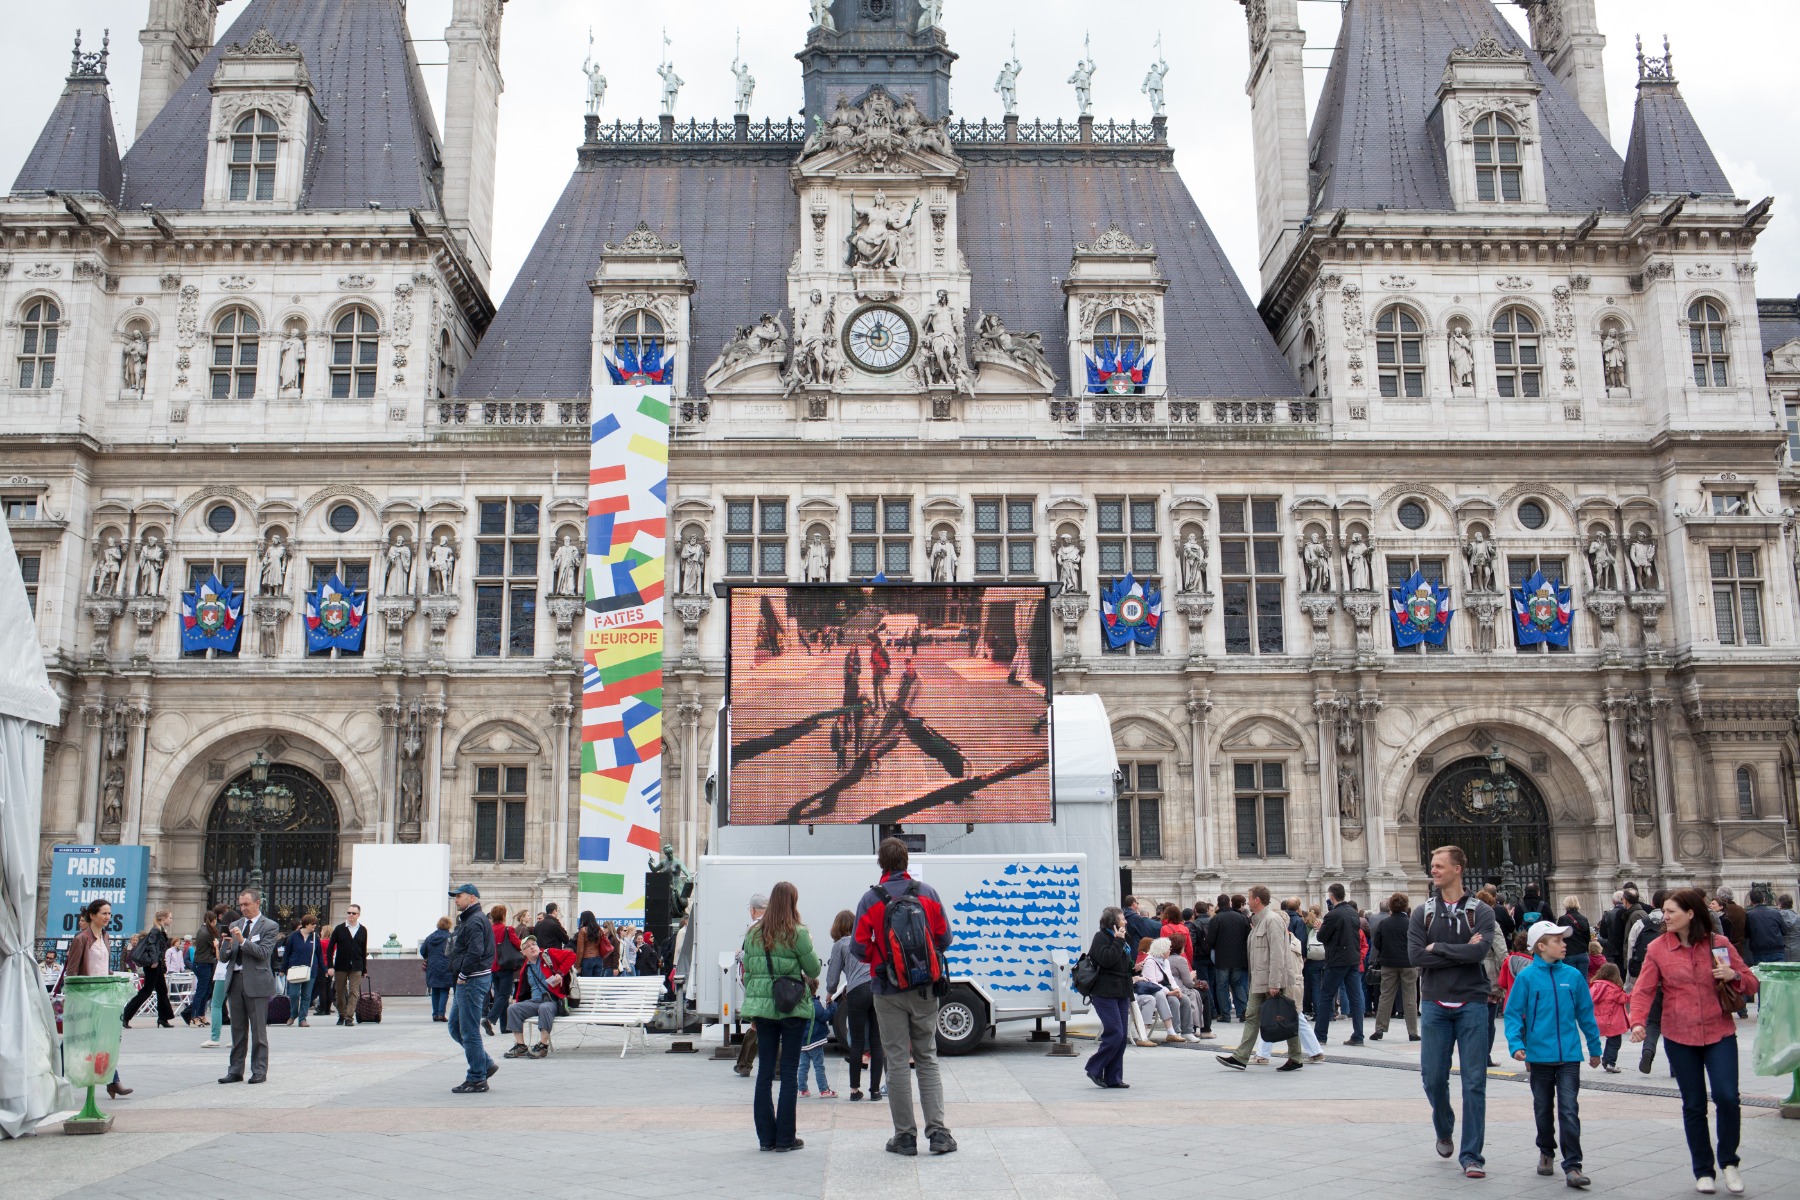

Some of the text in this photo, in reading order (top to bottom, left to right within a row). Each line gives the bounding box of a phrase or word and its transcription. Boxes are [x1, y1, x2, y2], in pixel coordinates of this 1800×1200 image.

[743, 403, 784, 415] LIBERTÉ
[969, 403, 1023, 415] FRATERNITÉ
[594, 608, 644, 628] FAITES
[590, 632, 657, 645] L'EUROPE
[67, 857, 116, 875] PARIS
[82, 877, 127, 888] S'ENGAGE
[81, 888, 126, 904] LIBERTÉ
